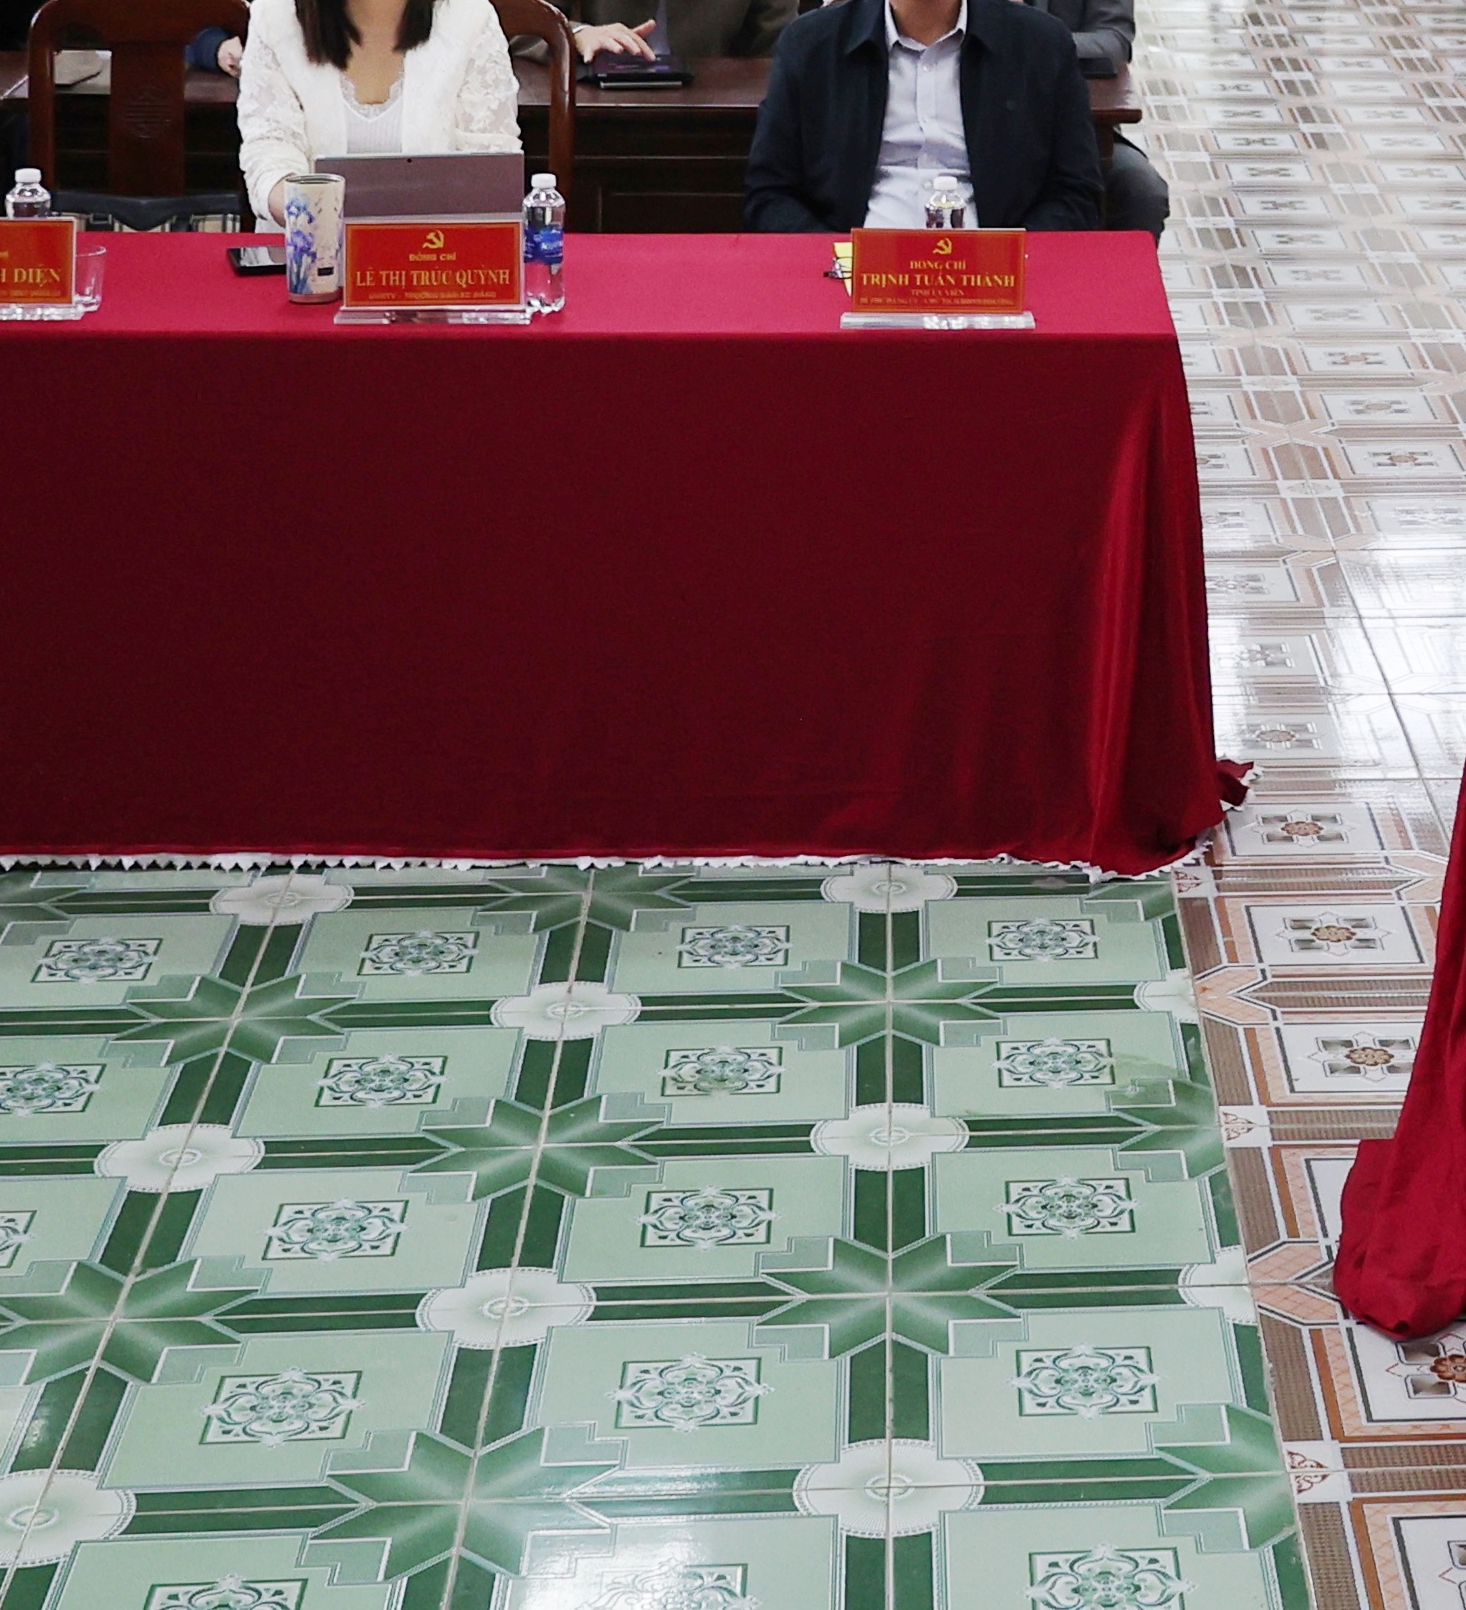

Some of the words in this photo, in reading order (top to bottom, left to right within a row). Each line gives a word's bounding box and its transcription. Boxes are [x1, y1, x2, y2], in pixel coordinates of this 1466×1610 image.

[356, 267, 375, 287] LÊ
[379, 271, 406, 289] THỊ
[410, 266, 452, 286] TRÚC
[456, 264, 510, 288] QUỲNH
[861, 273, 909, 288] TRỊNH
